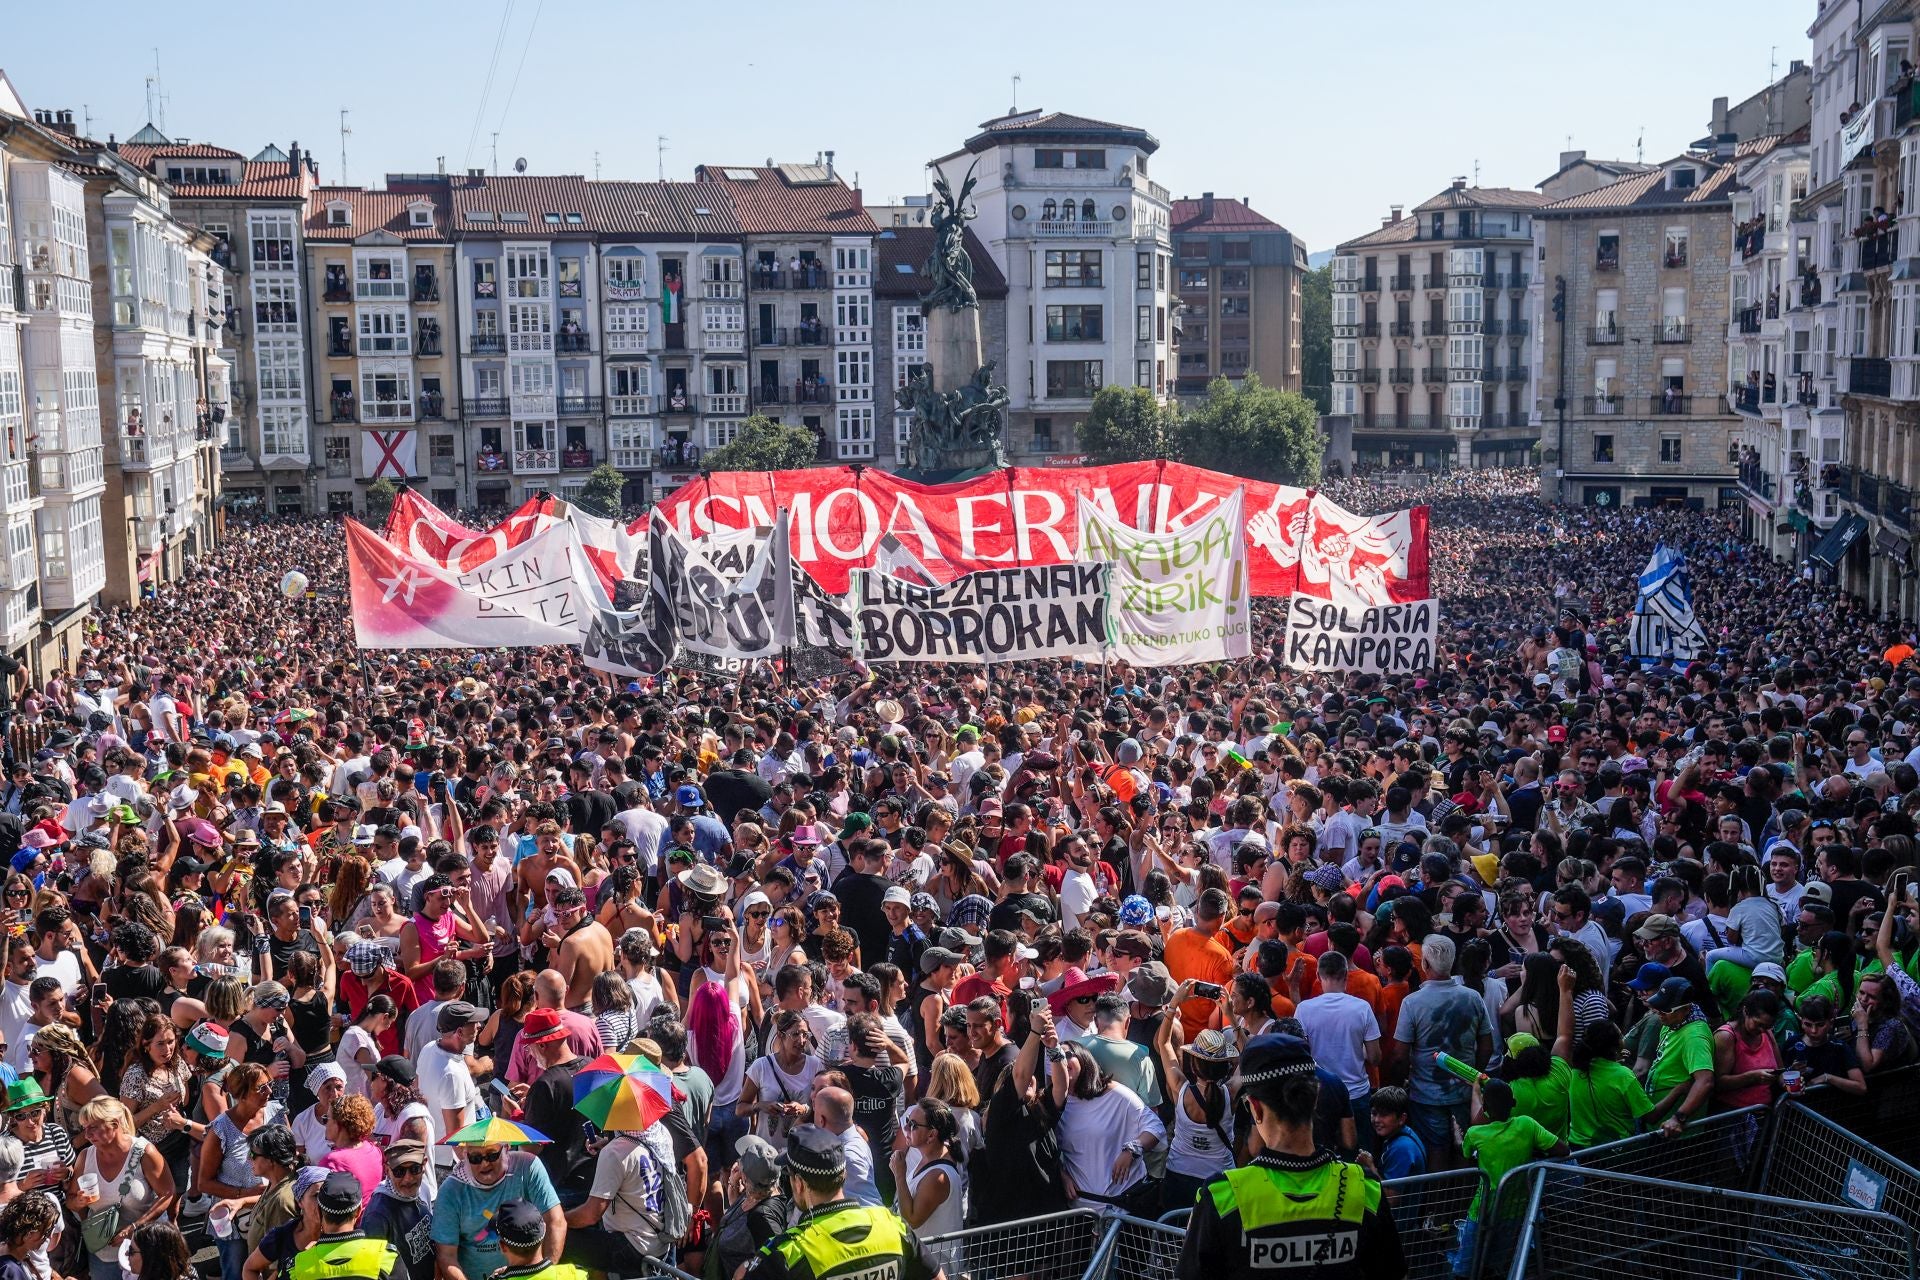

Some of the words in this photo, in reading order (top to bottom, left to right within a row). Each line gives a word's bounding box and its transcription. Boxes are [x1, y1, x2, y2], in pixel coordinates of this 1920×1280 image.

[858, 597, 1106, 660] BORROKAN
[1290, 631, 1430, 670] KANPORA
[1254, 1237, 1354, 1264] POLIZIA
